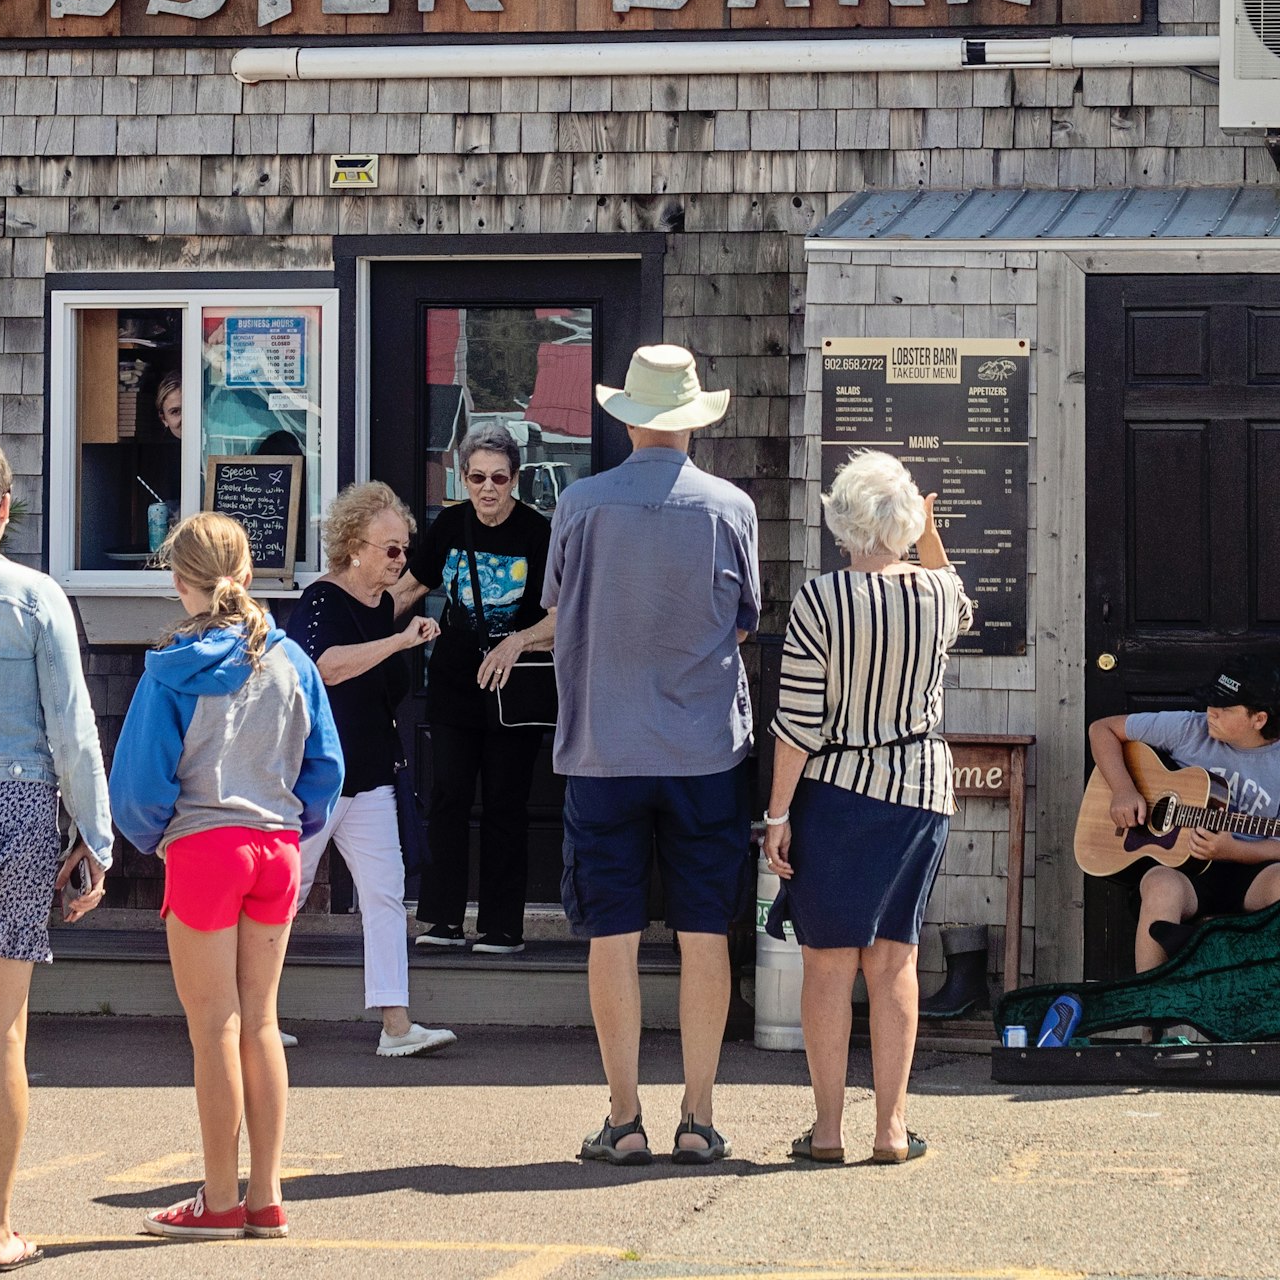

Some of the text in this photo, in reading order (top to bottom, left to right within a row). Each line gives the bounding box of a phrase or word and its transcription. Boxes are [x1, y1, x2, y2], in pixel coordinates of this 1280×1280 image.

[238, 319, 294, 328] BUSINESS HOURS
[892, 347, 958, 366] LOBSTER BARN
[824, 358, 884, 370] 902.658.2722
[892, 367, 958, 379] TAKEOUT MENU
[836, 386, 861, 396] SALADS
[968, 386, 1007, 396] APPETIZERS
[909, 436, 940, 449] MAINS
[221, 466, 257, 479] Special
[263, 521, 283, 530] with
[265, 542, 284, 557] only
